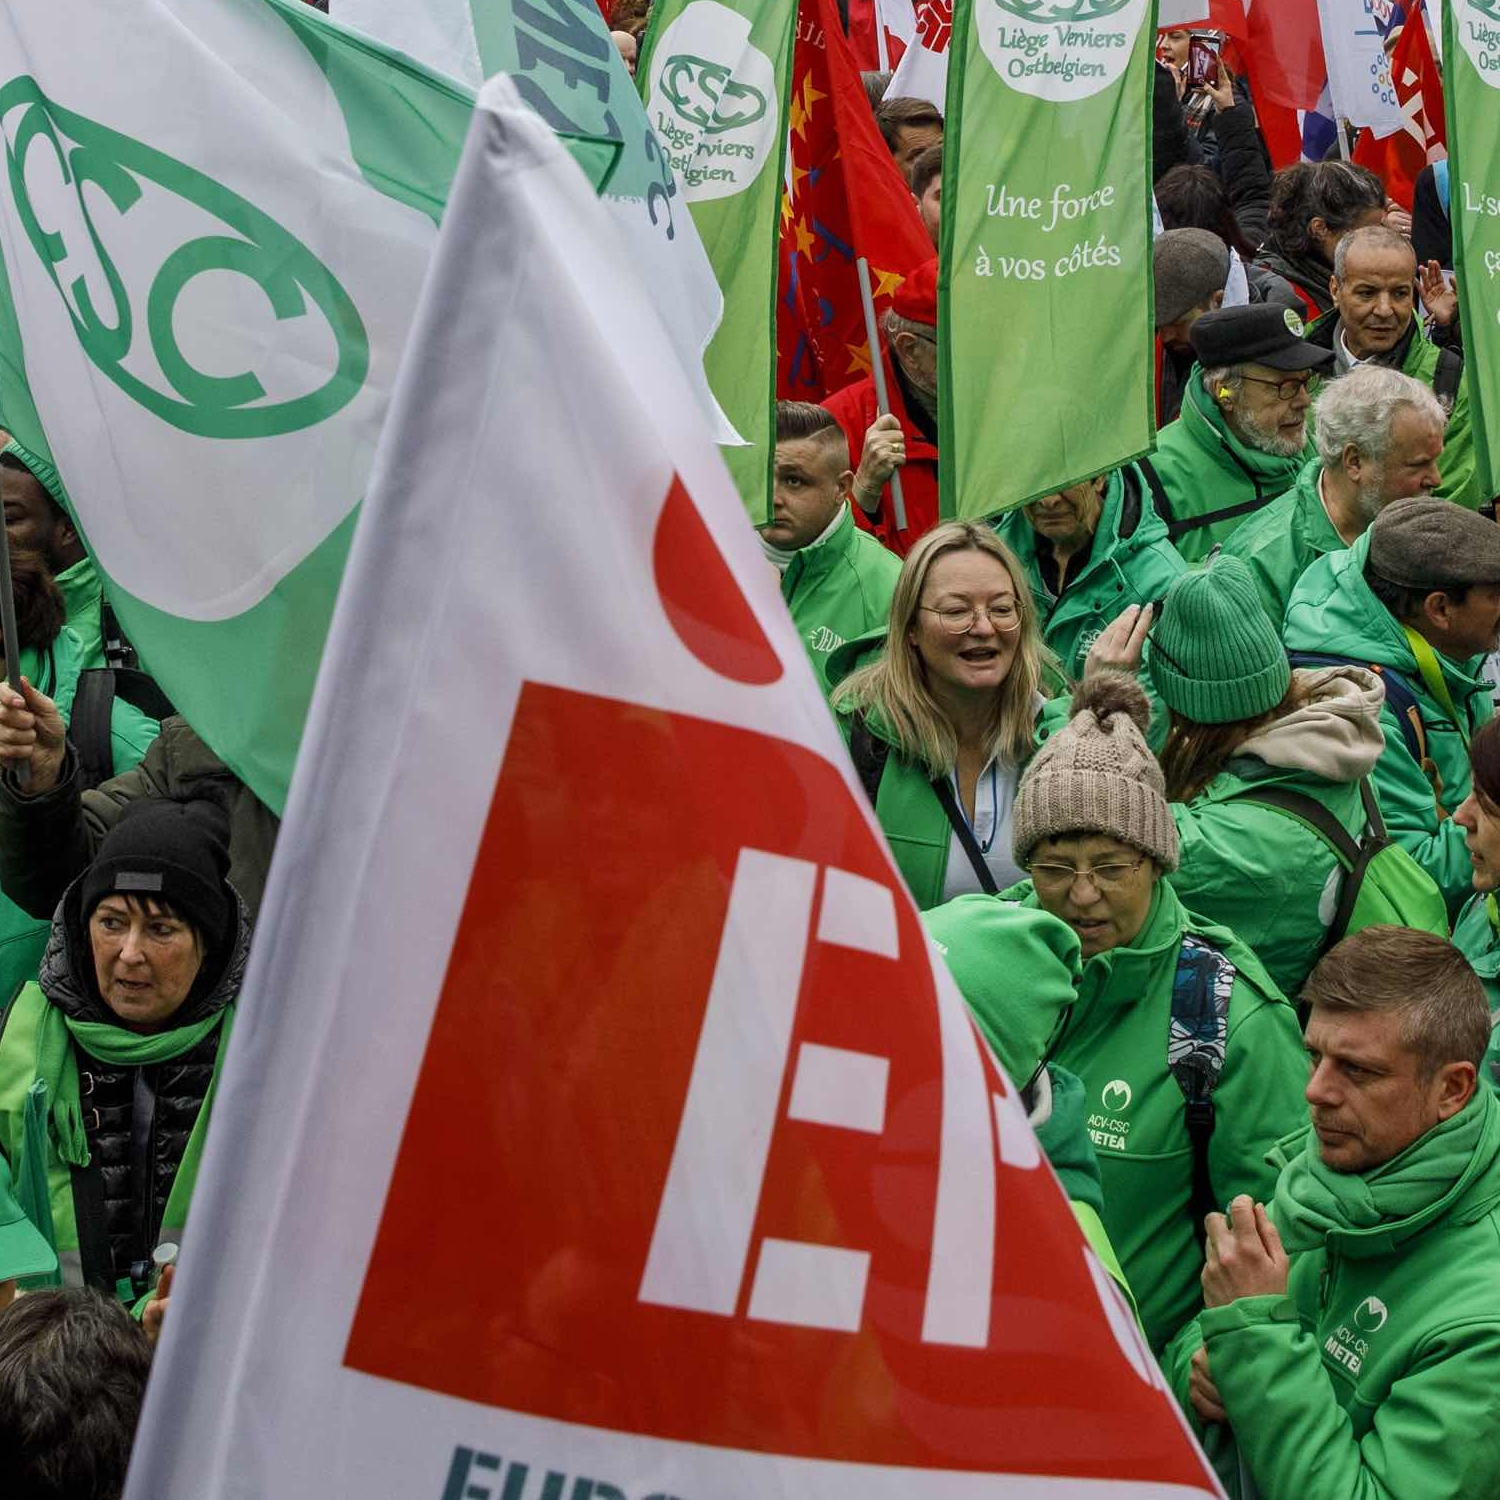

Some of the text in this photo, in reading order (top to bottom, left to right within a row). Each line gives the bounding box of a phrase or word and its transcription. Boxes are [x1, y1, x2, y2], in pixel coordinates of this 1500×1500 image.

[998, 25, 1126, 66] Liège Verviers
[1006, 56, 1107, 81] Ostbelgien
[662, 58, 765, 130] CSC
[656, 111, 695, 153] Liège
[985, 182, 1115, 233] Une force
[11, 105, 308, 410] CSC
[975, 238, 1122, 282] à vos côtés
[1088, 1113, 1131, 1135] ACV-CSC
